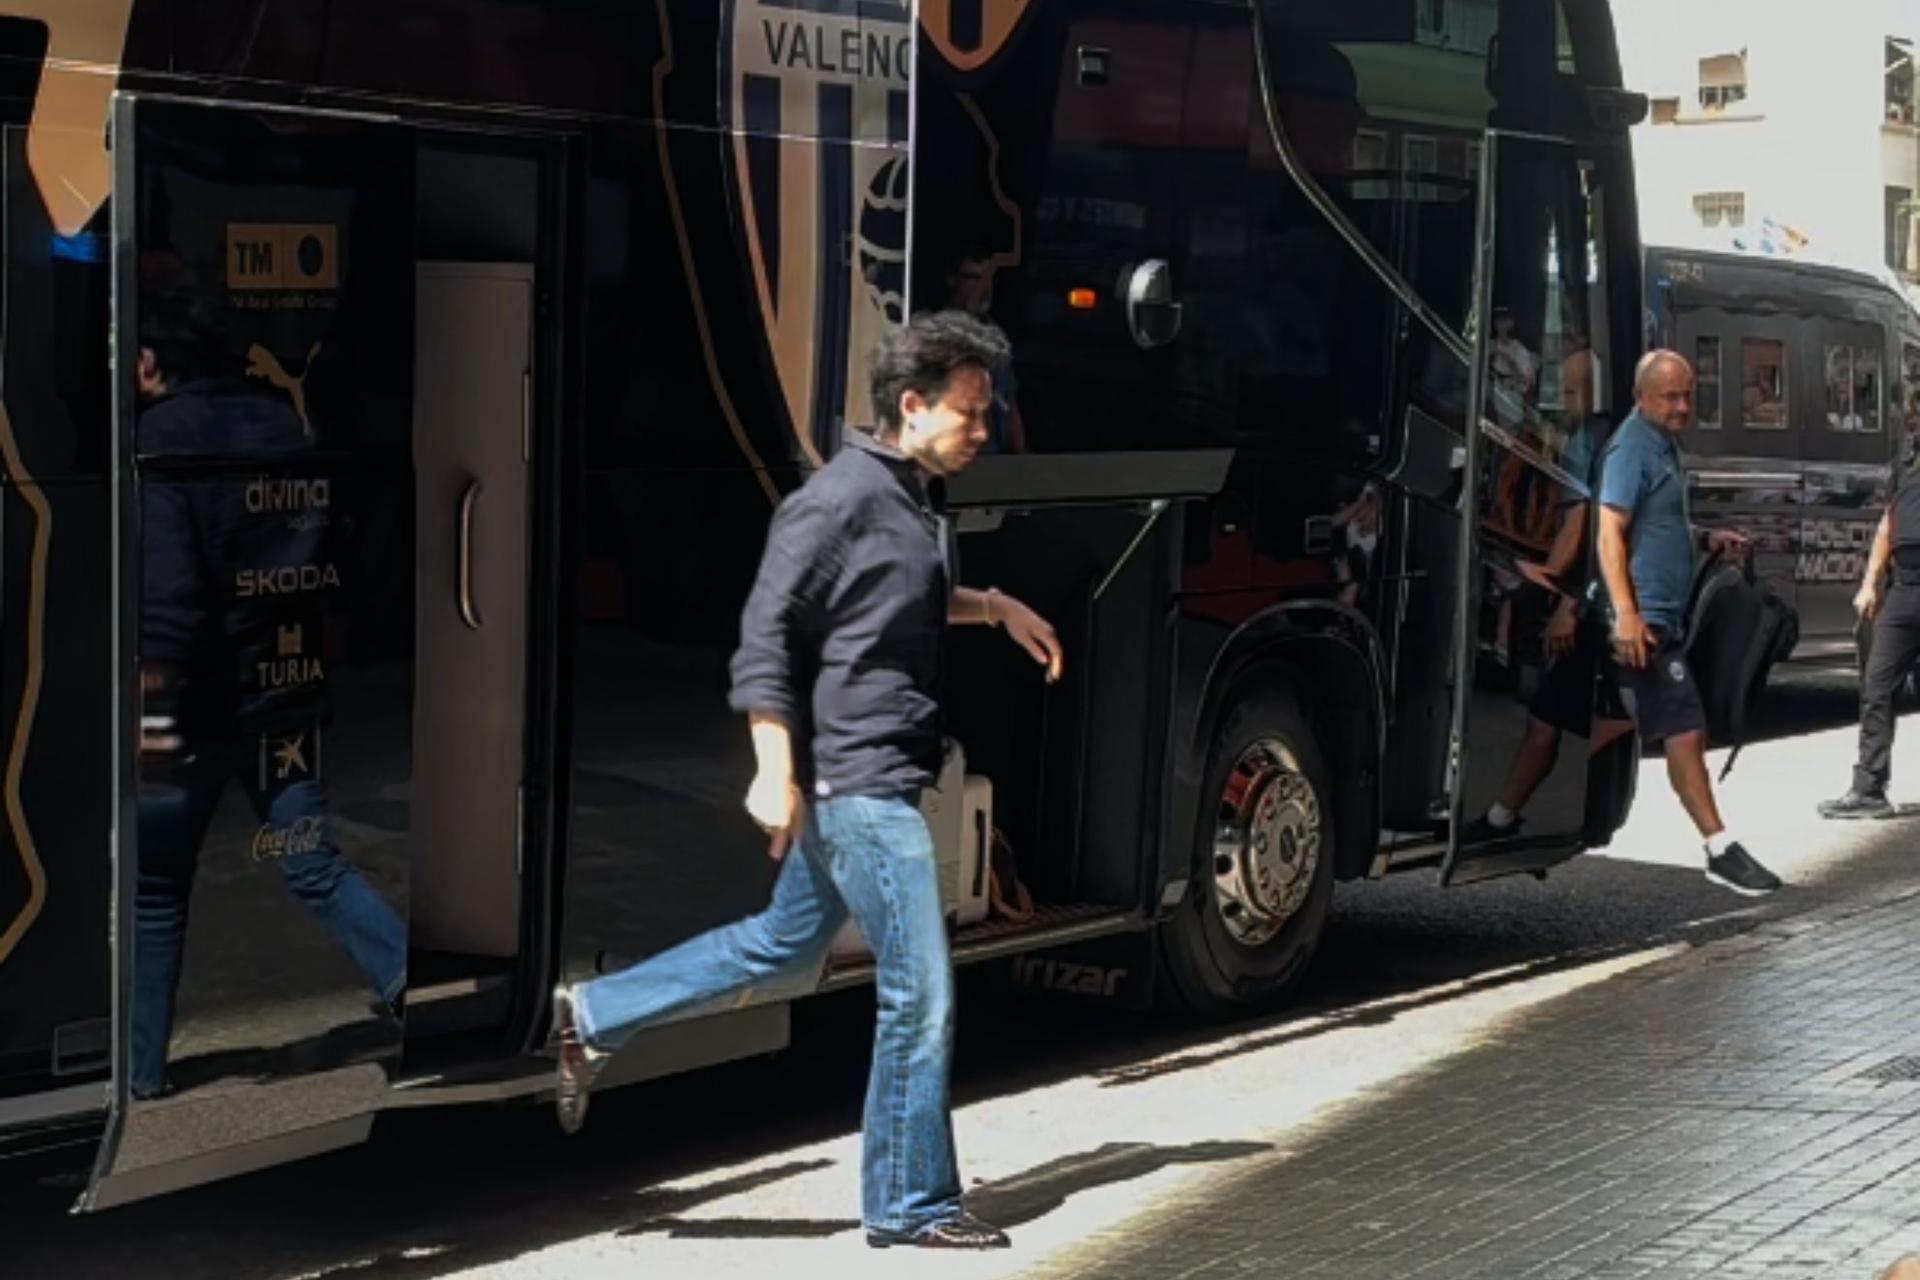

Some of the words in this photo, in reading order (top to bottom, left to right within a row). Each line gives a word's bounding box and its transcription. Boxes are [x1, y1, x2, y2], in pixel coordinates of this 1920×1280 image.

[234, 241, 273, 275] TM
[245, 473, 331, 513] divina
[235, 562, 341, 597] SKODA
[256, 657, 325, 688] TURIA
